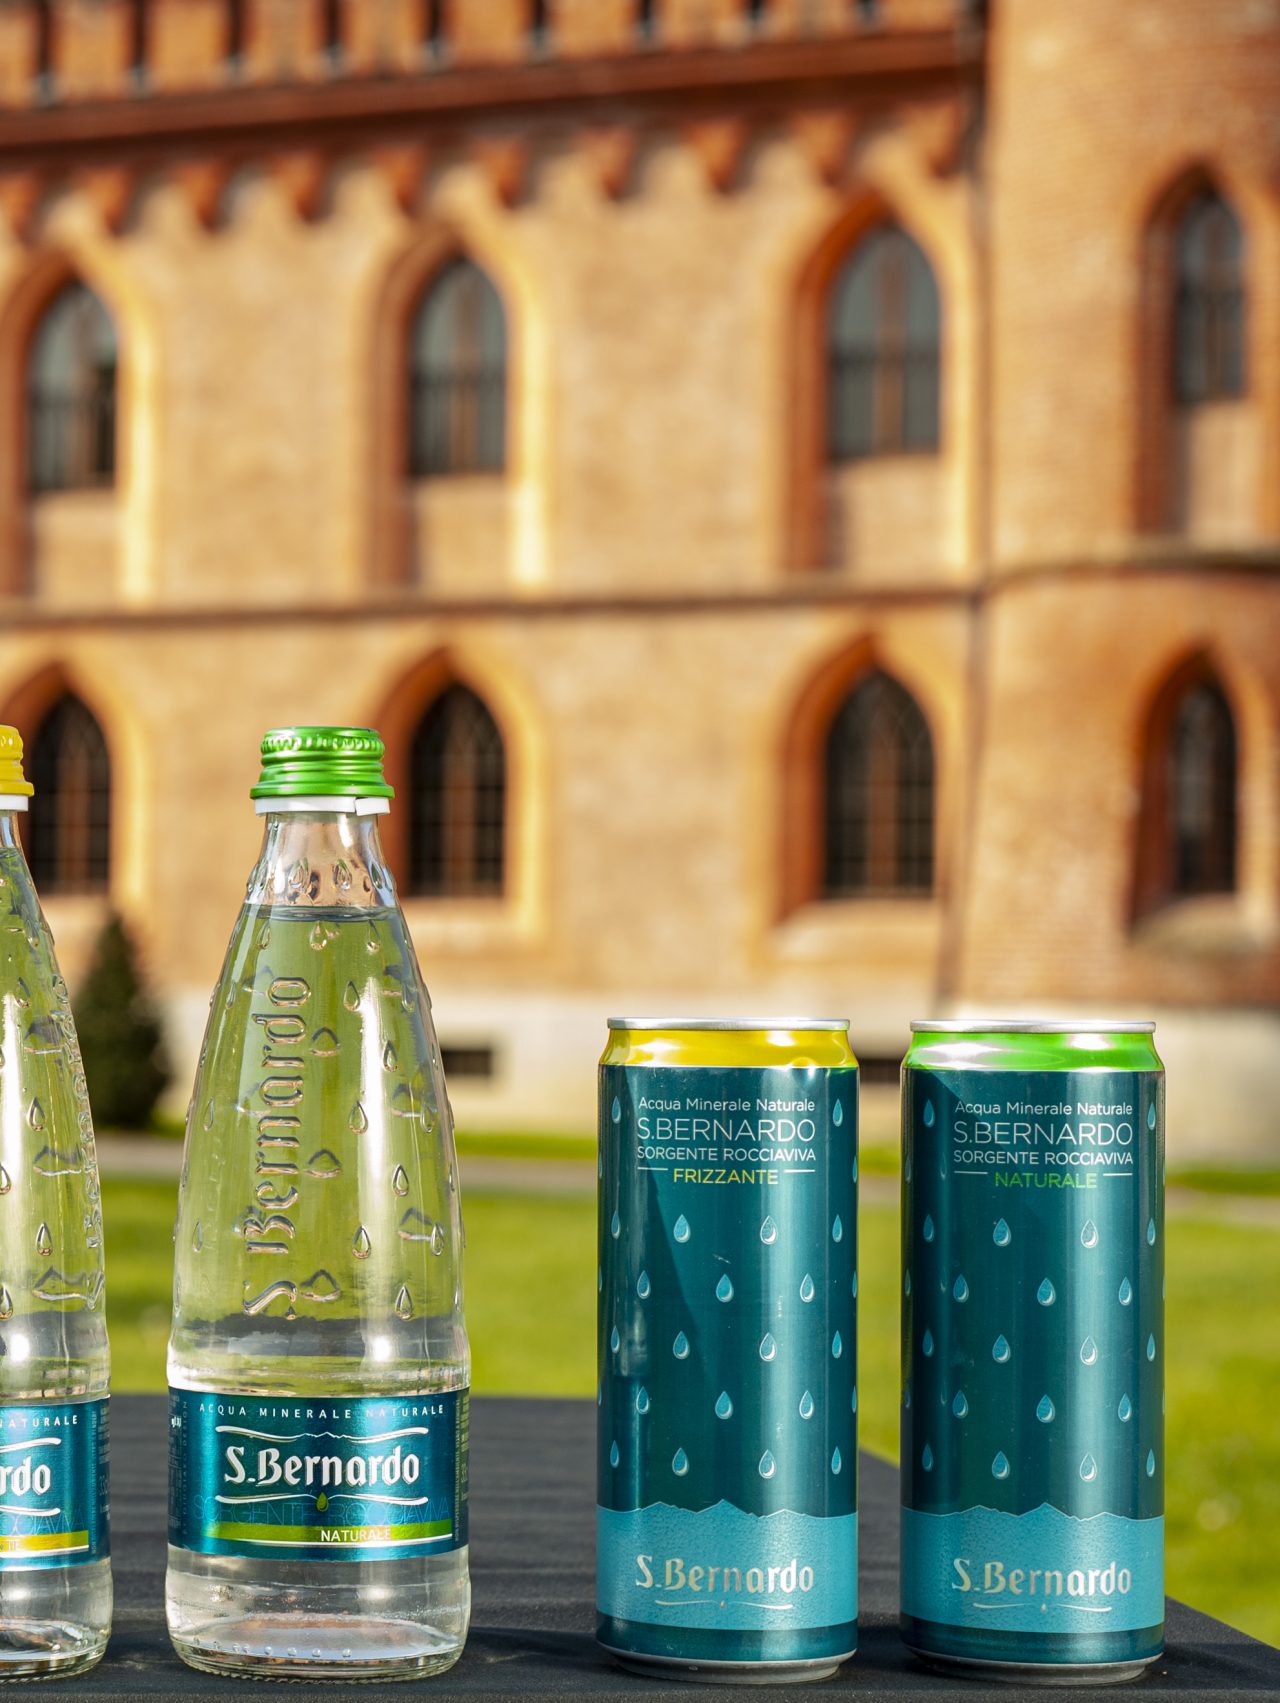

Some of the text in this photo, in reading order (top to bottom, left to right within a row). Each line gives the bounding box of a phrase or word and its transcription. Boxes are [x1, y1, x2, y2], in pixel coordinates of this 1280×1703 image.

[638, 1096, 815, 1114] Acqua Minerale Naturale
[955, 1100, 1133, 1116] Acqua Minerale Naturale
[637, 1117, 816, 1143] S.BERNARDO
[953, 1121, 1133, 1146] S.BERNARDO
[637, 1146, 816, 1162] SORGENTE ROCCIAVIVA
[953, 1150, 1134, 1166] SORGENTE ROCCIAVIVA
[673, 1168, 779, 1185] FRIZZANTE
[995, 1172, 1097, 1189] NATURALE
[199, 1404, 444, 1419] ACQUA MINERALE NATURALE
[224, 1446, 420, 1487] S.Bernardo
[321, 1529, 391, 1543] NATURALE
[635, 1554, 814, 1594] S.Bernardo
[952, 1557, 1132, 1597] S.Bernardo
